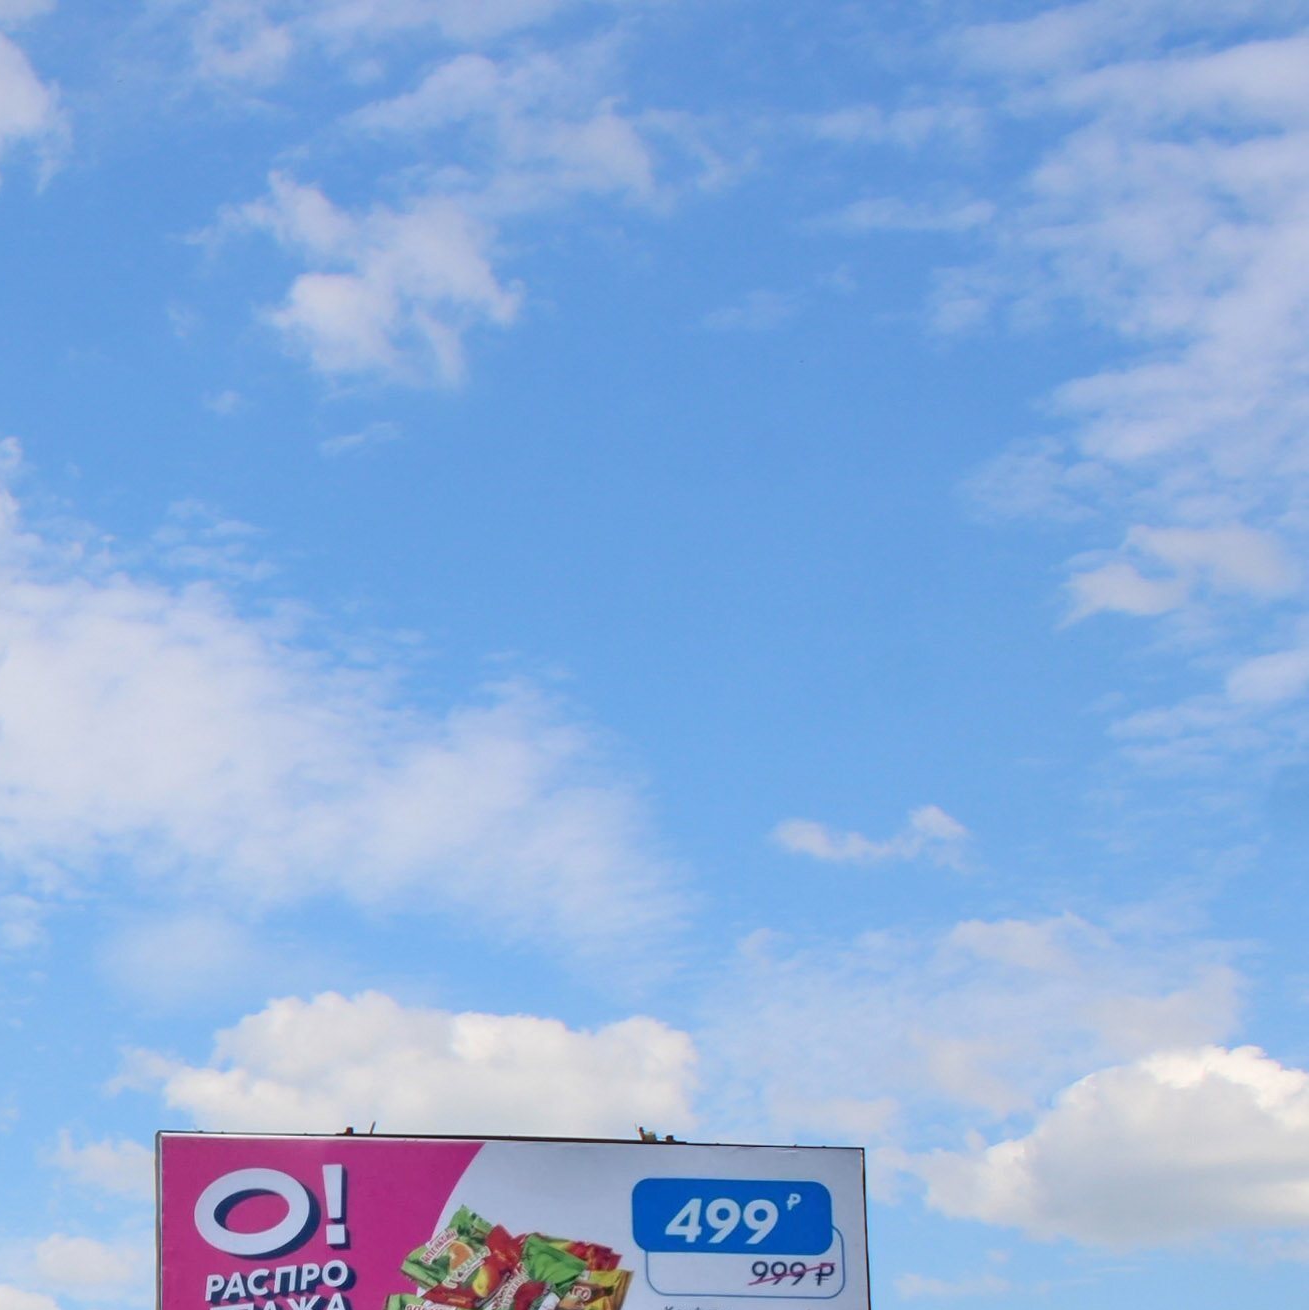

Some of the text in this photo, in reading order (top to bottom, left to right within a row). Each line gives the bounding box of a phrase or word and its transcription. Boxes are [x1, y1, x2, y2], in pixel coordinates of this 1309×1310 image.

[664, 1198, 779, 1245] 499
[205, 1260, 351, 1302] РАСПРО
[751, 1261, 807, 1286] 999
